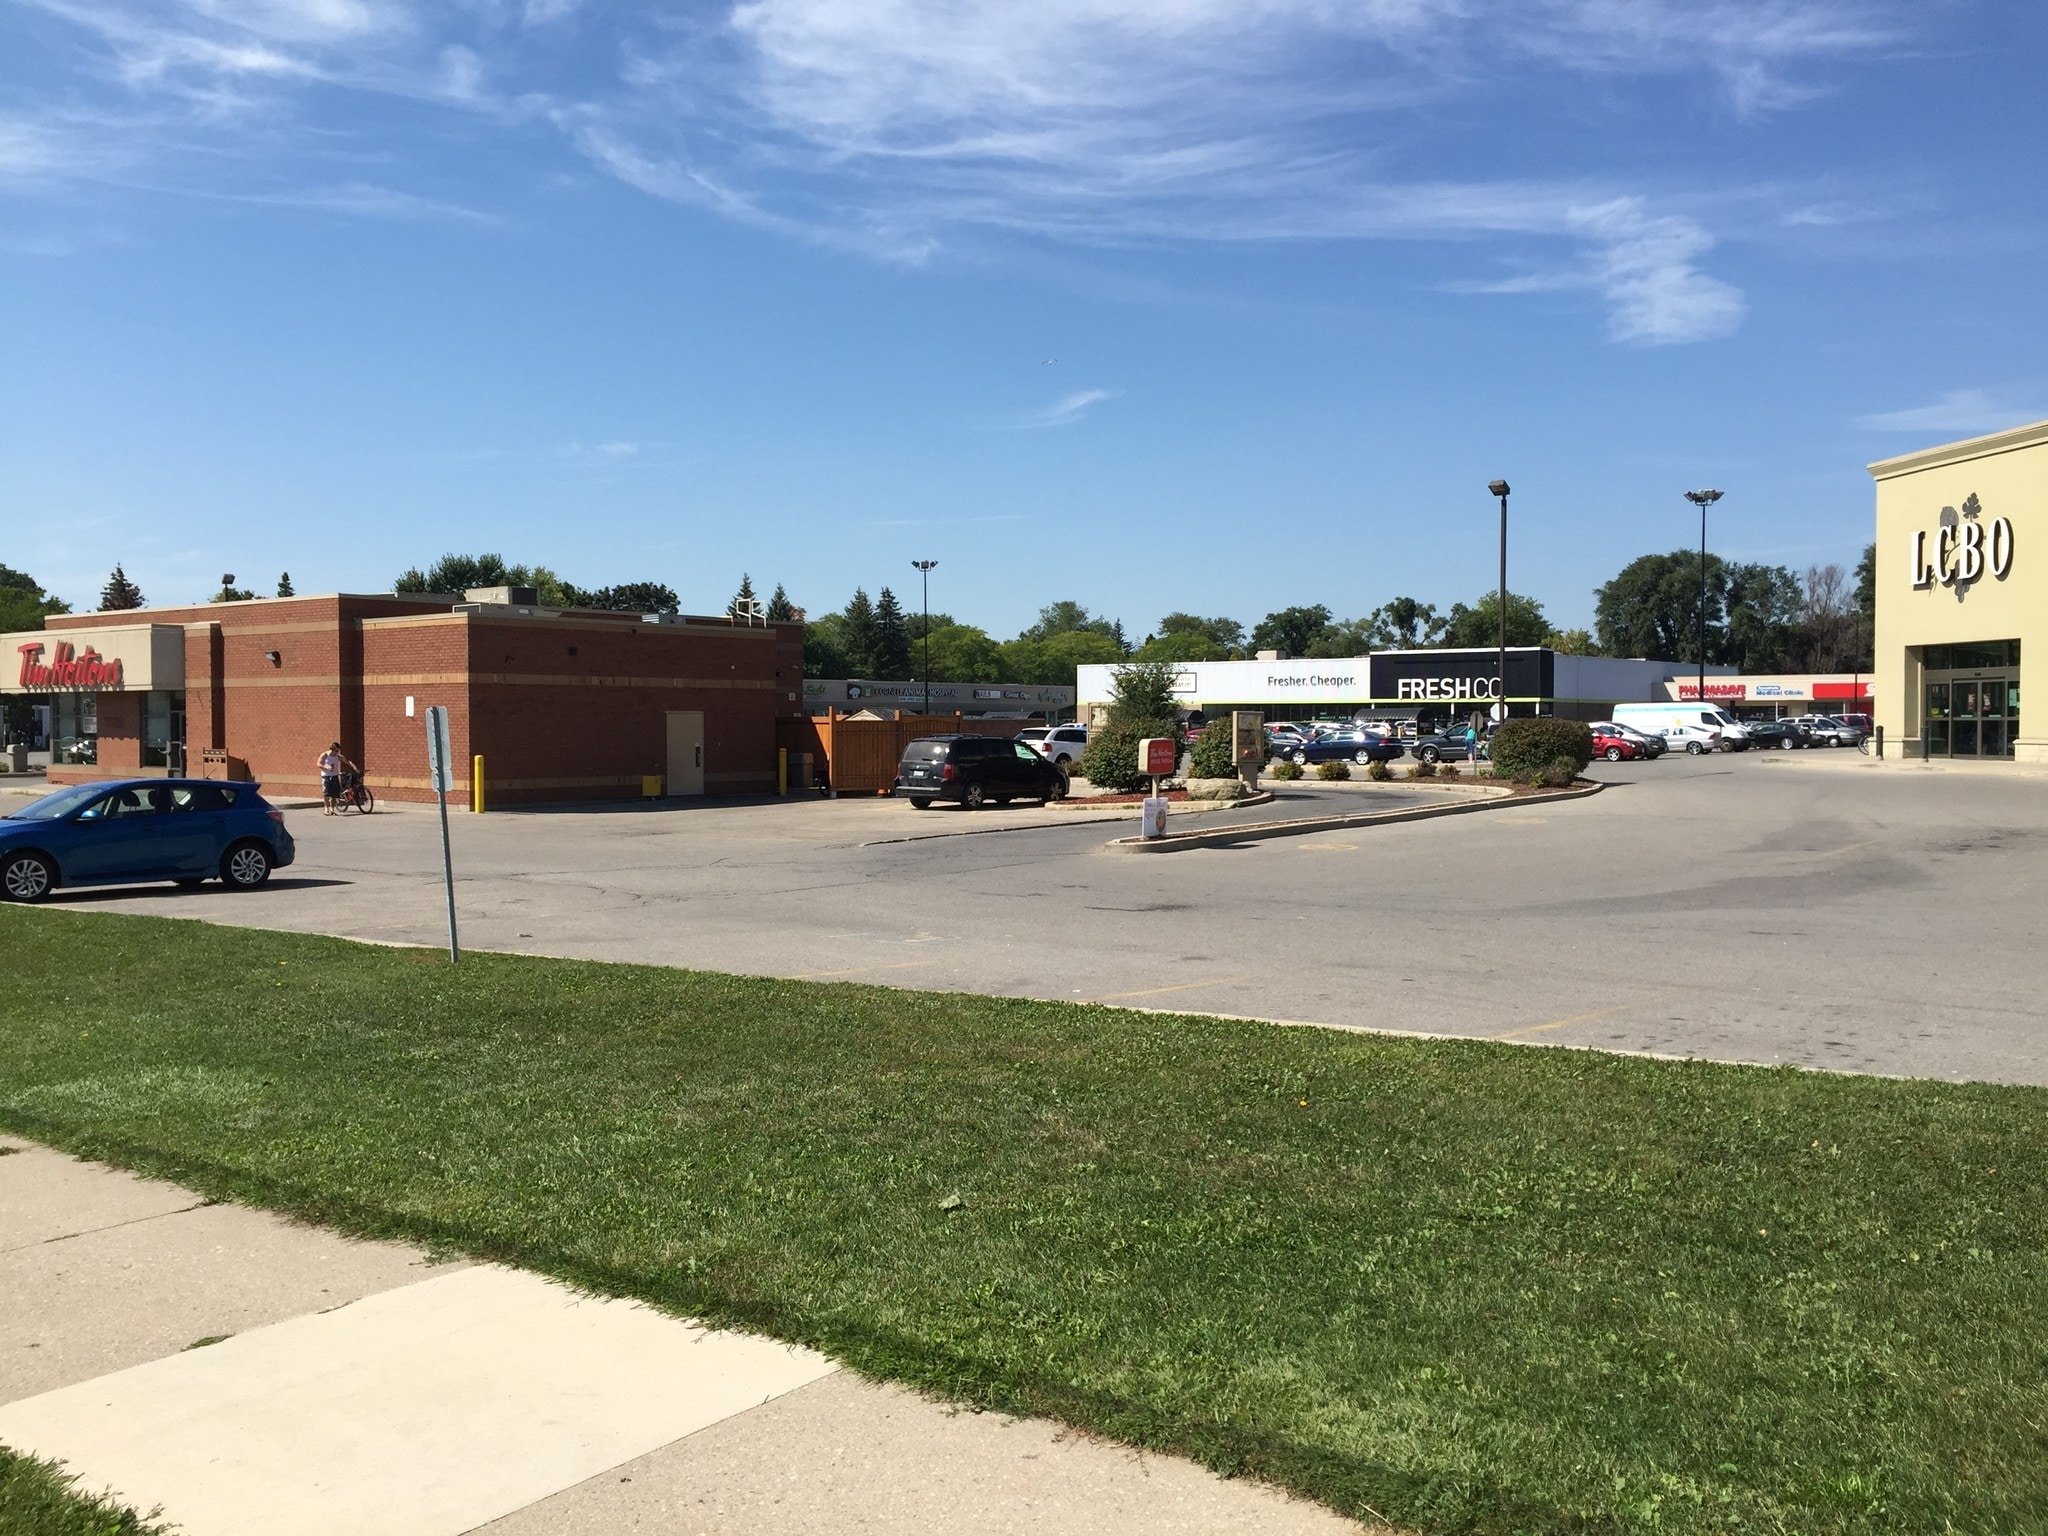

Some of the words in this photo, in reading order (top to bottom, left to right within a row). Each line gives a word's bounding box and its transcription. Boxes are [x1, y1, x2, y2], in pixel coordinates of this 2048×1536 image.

[1910, 516, 2011, 587] LCBO
[17, 642, 49, 688] Tim
[51, 640, 121, 688] Hortons
[903, 687, 926, 697] ANIMA
[1267, 676, 1308, 687] Fresher.
[1309, 675, 1357, 688] Cheaper.
